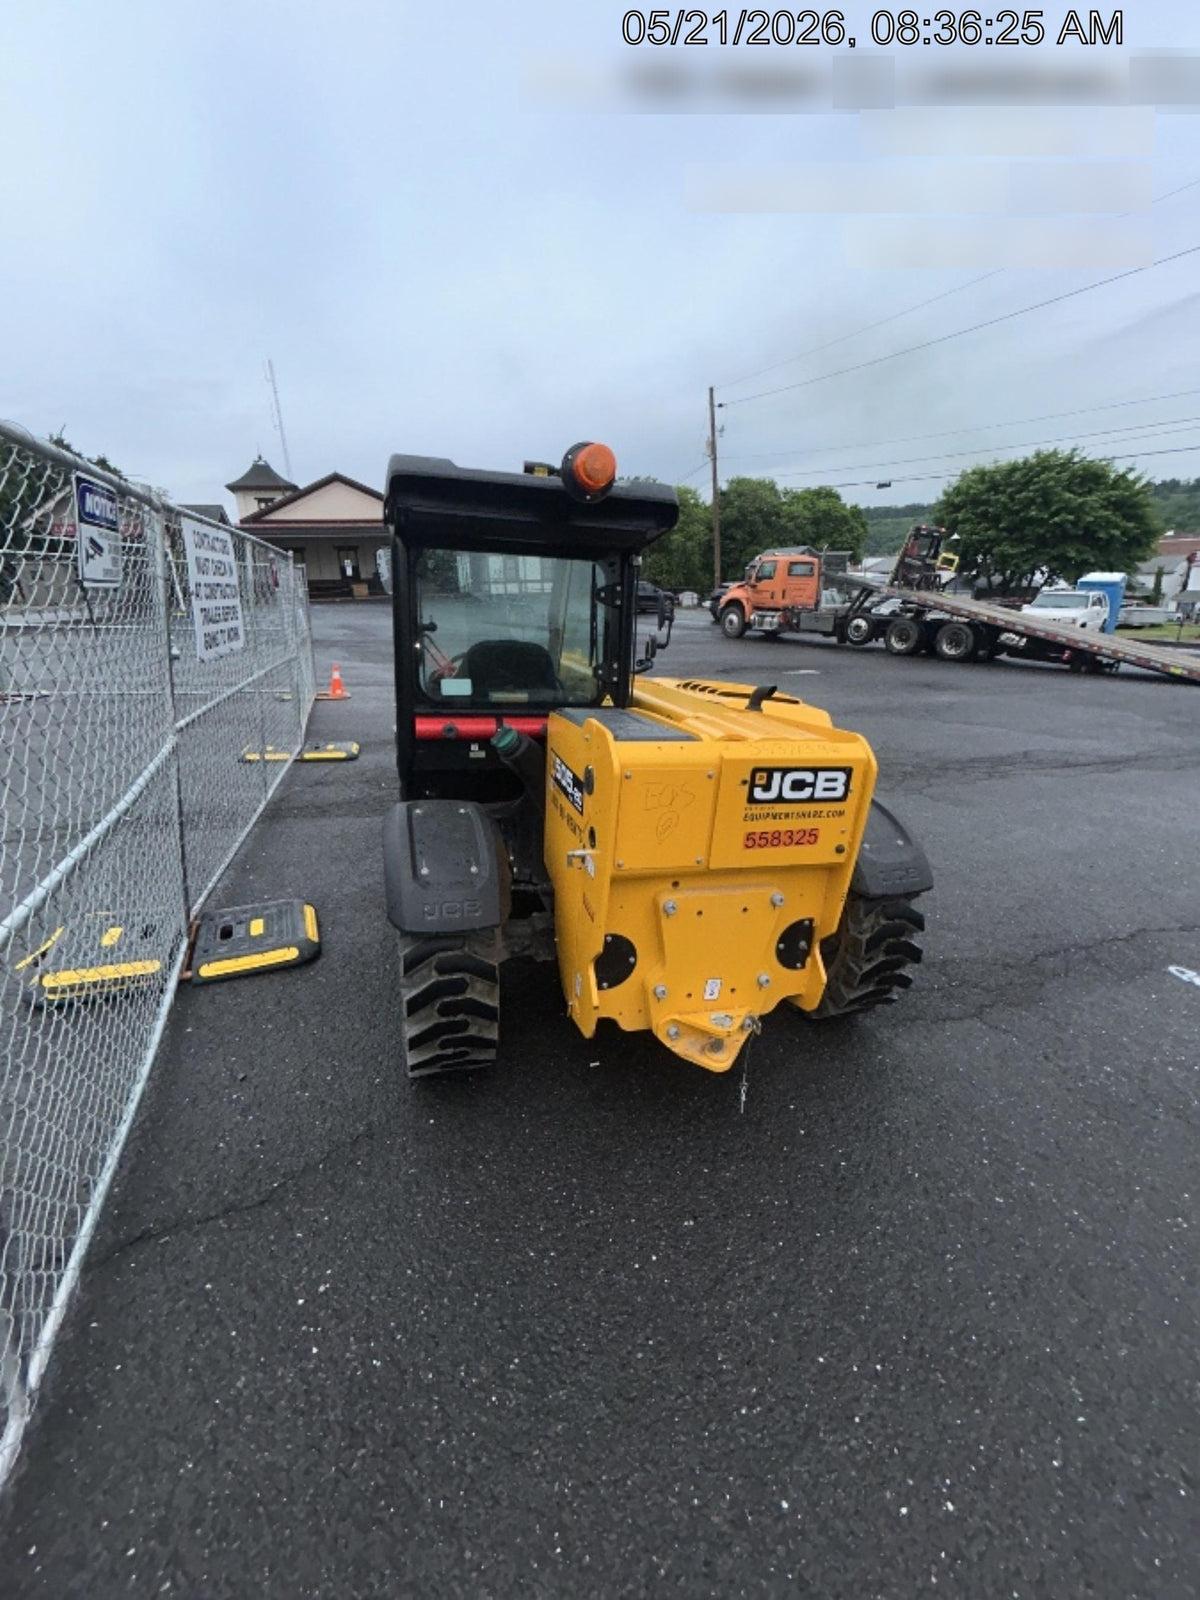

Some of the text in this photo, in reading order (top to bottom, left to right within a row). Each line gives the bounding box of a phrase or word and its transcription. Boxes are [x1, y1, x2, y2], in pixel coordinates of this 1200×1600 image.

[752, 771, 847, 800] JCB
[743, 809, 846, 822] EQUIPMENTSHARE.COM
[744, 828, 820, 849] 558325
[423, 898, 482, 921] JCB
